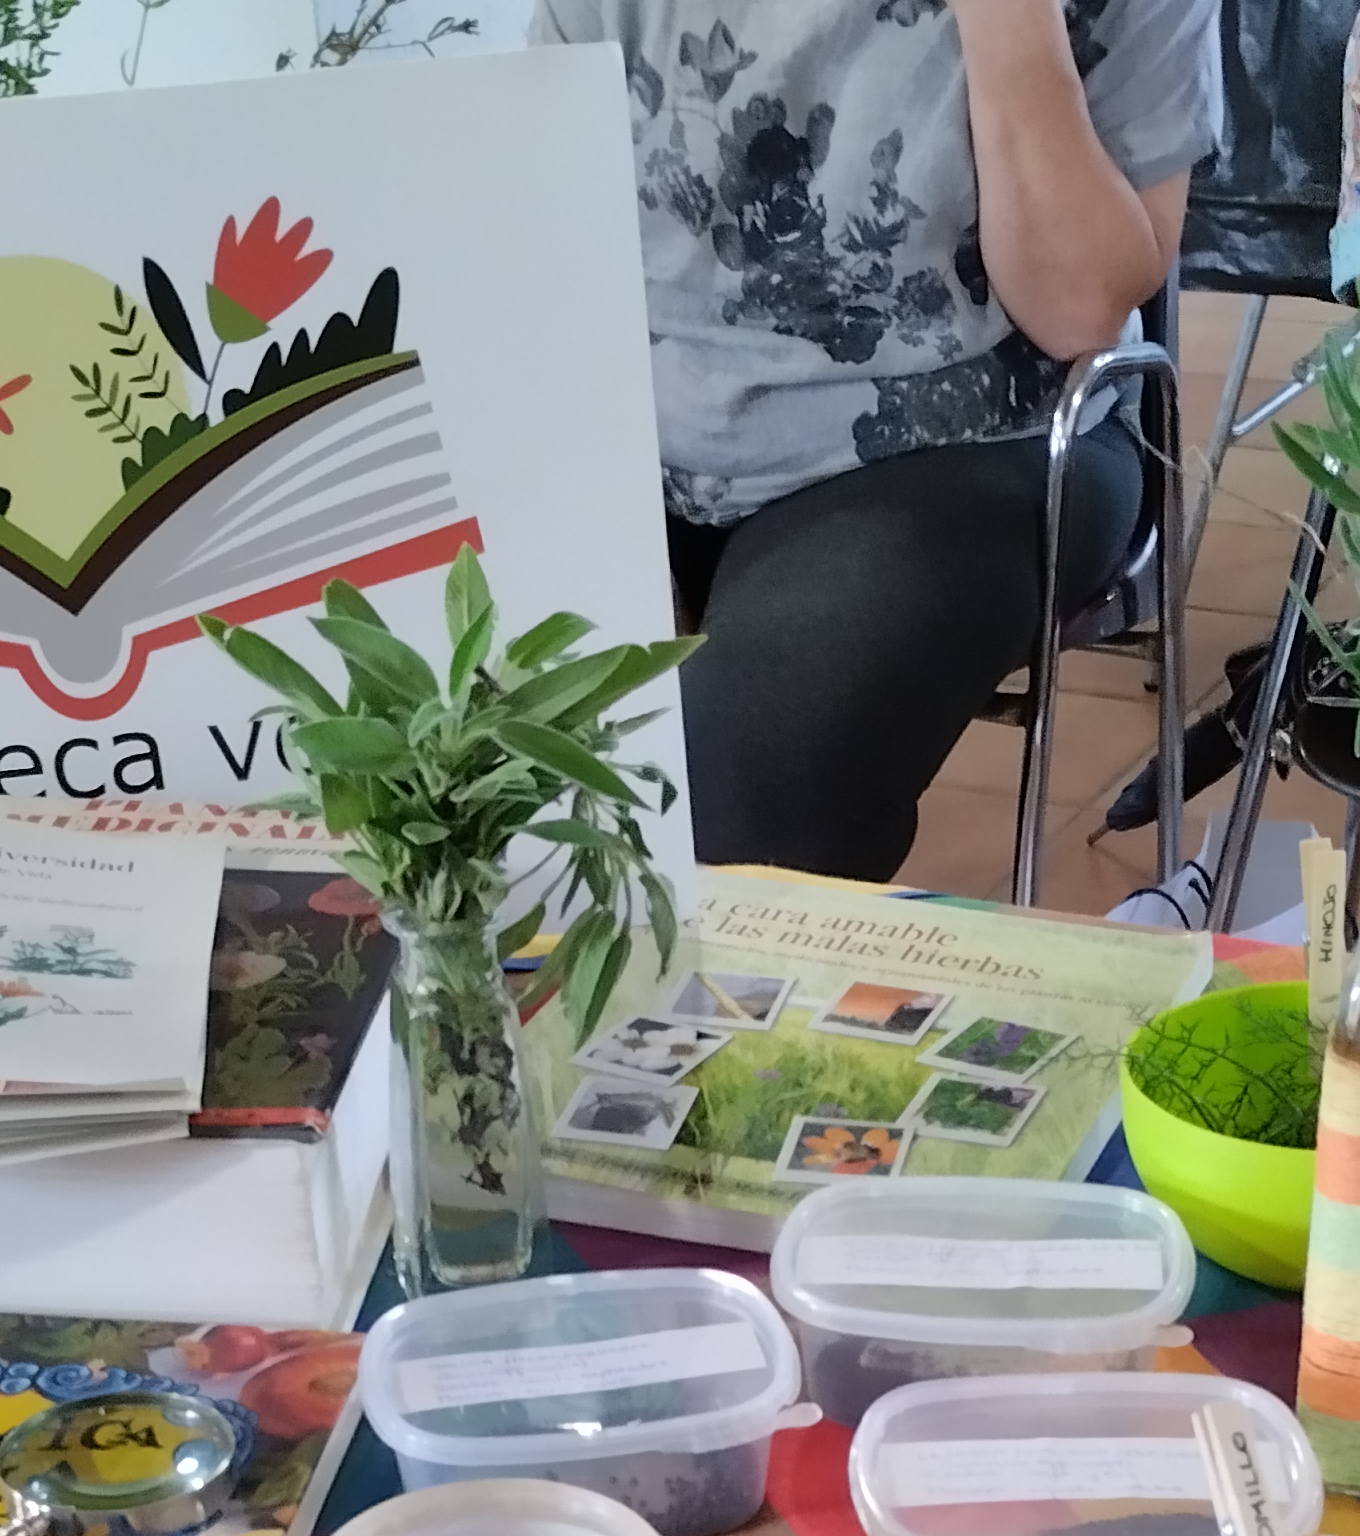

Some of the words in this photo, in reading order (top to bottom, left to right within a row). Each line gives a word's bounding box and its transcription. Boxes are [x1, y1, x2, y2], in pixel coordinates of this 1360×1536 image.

[715, 916, 769, 941] las
[777, 929, 886, 959] malas
[899, 944, 1045, 981] hierbas
[730, 902, 808, 926] cara
[820, 917, 959, 947] amable
[1319, 884, 1337, 963] HINOJO
